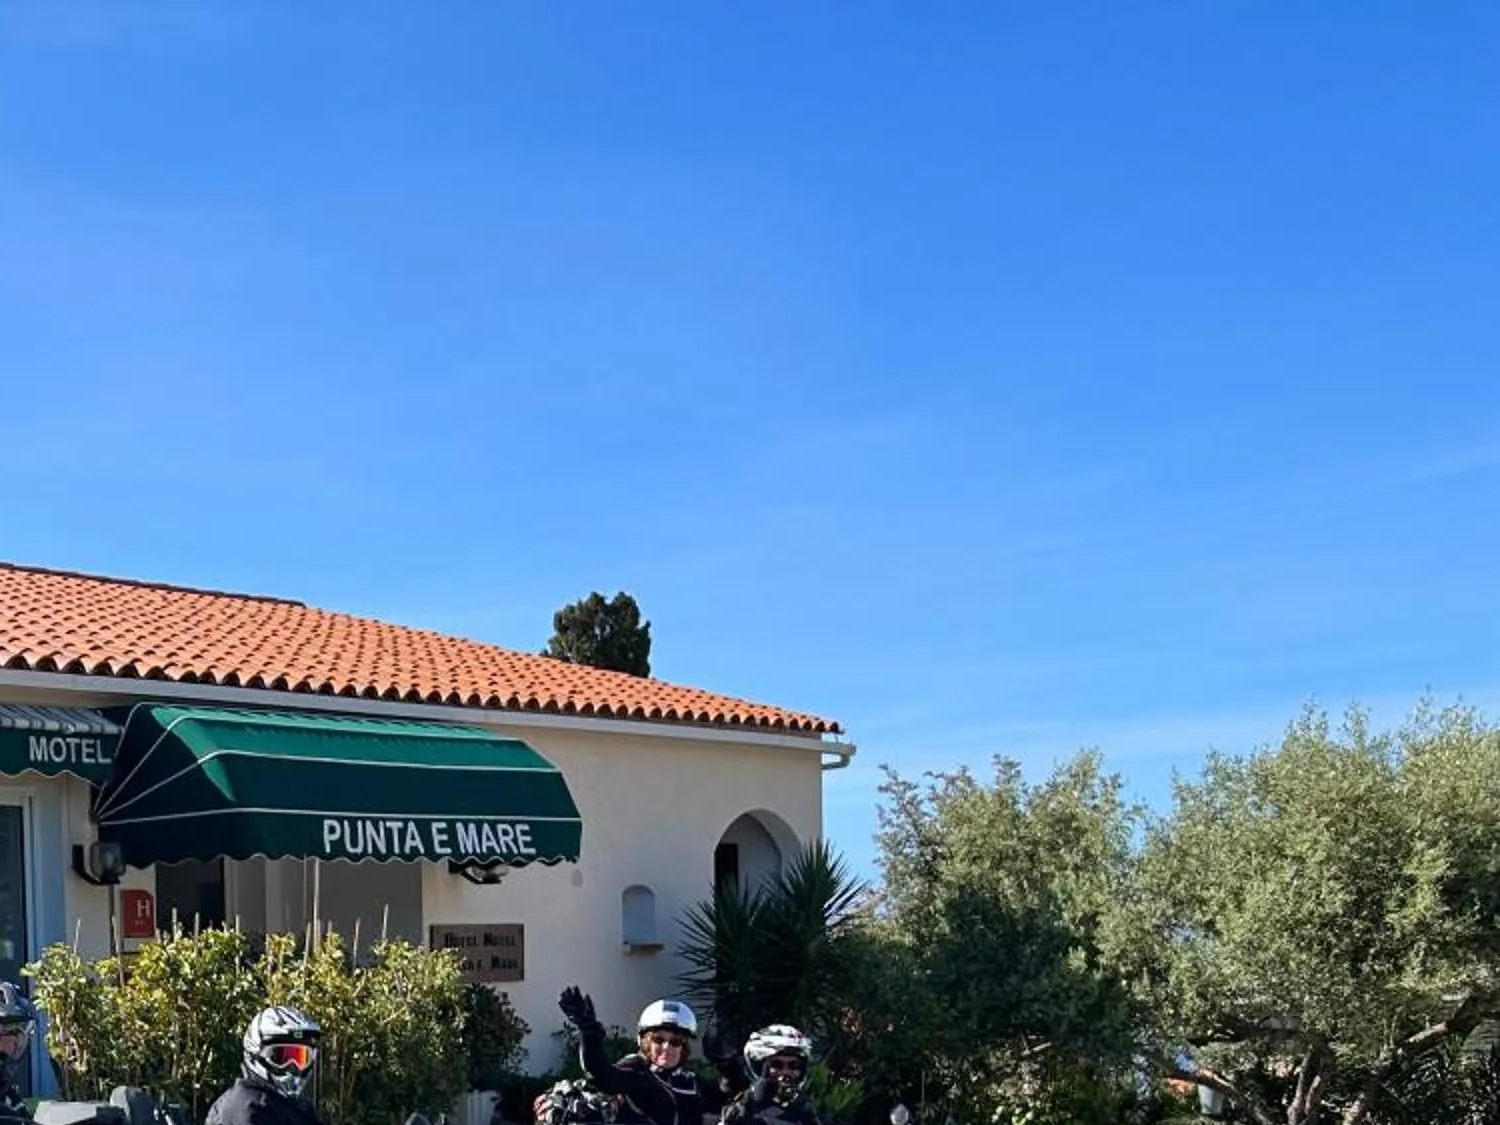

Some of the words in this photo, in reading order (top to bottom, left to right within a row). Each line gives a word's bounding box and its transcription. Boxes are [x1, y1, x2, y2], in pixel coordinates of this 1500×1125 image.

[28, 735, 112, 764] MOTEL
[323, 819, 425, 854] PUNTA
[431, 821, 452, 854] E
[455, 821, 537, 855] MARE
[136, 899, 150, 918] H
